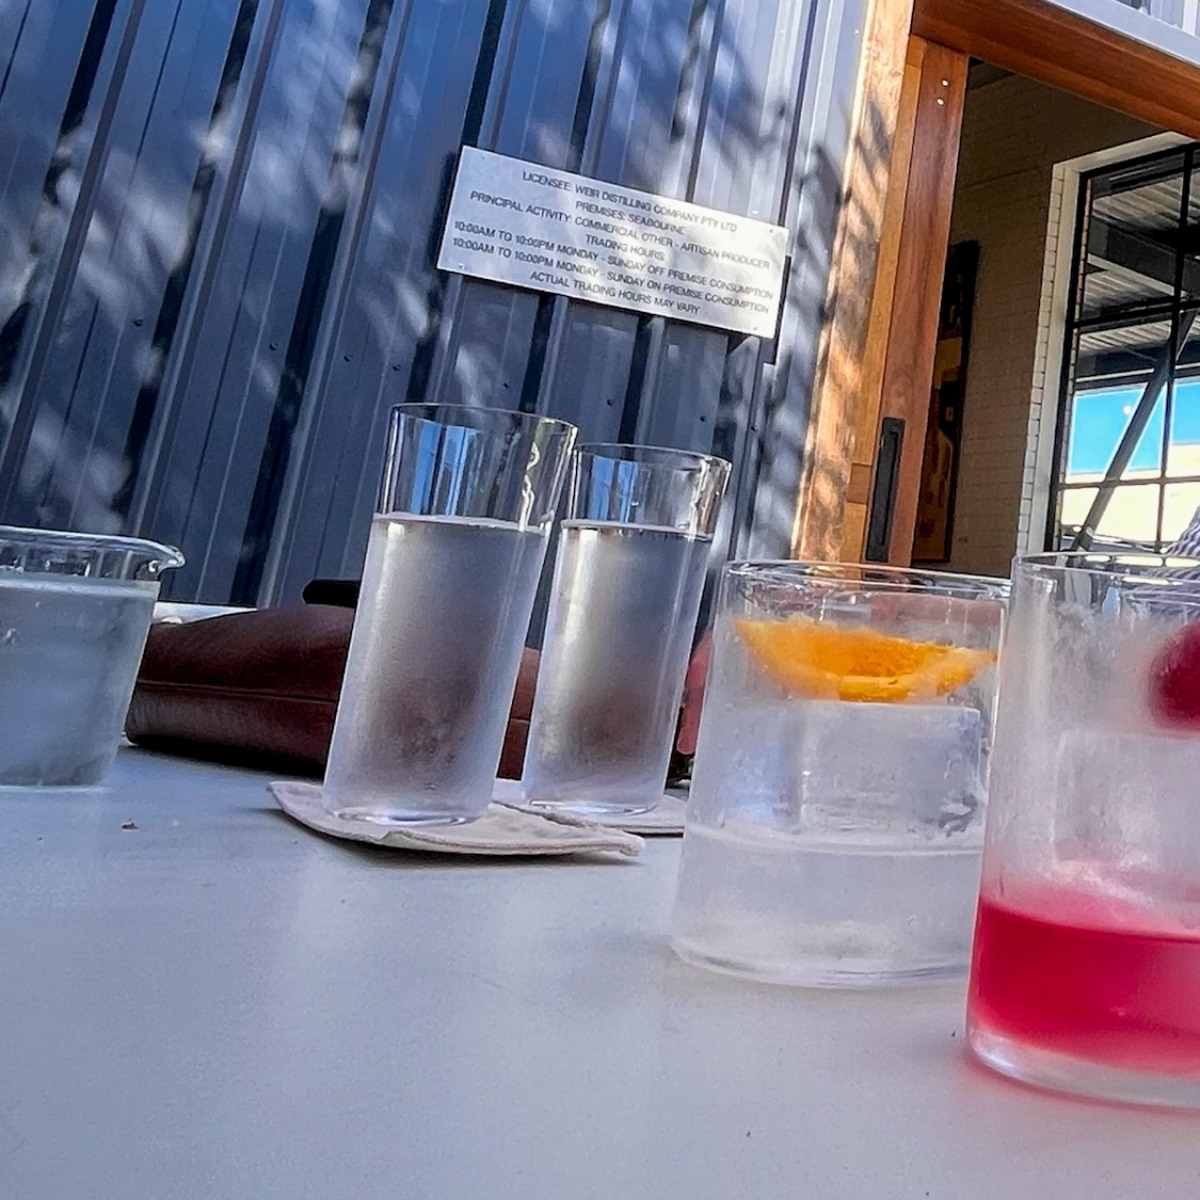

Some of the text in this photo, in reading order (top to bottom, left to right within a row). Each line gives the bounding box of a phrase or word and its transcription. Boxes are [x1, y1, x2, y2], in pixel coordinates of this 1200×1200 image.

[470, 190, 523, 213] PRINCIPAL
[574, 216, 640, 240] COMMERCIAL
[641, 232, 673, 248] OTHER
[680, 242, 720, 259] ARTISAN
[721, 251, 770, 270] PRODUCER
[601, 190, 651, 212] DISTILLING
[653, 204, 700, 223] COMPANY
[701, 216, 720, 229] PTY
[720, 221, 738, 233] LTD
[628, 213, 687, 236] SEABOURNE
[454, 220, 496, 238] 10:00AM
[498, 230, 513, 242] TO
[515, 234, 555, 252] 10:00PM
[556, 244, 599, 261] MONDAY
[607, 255, 646, 272] SUNDAY
[647, 264, 666, 277] OFF
[667, 268, 709, 286] PREMISE
[709, 278, 773, 300] CONSUMPTION
[585, 233, 628, 251] TRADING
[453, 237, 495, 254] 10:00AM
[498, 246, 512, 259] TO
[514, 250, 554, 268] 10:00PM
[556, 260, 599, 278] MONDAY
[606, 272, 645, 288] SUNDAY
[646, 280, 662, 292] ON
[662, 283, 704, 301] PREMISE
[704, 292, 769, 315] CONSUMPTION
[530, 271, 701, 315] ACTUAL TRADING HOURS MAY VARY
